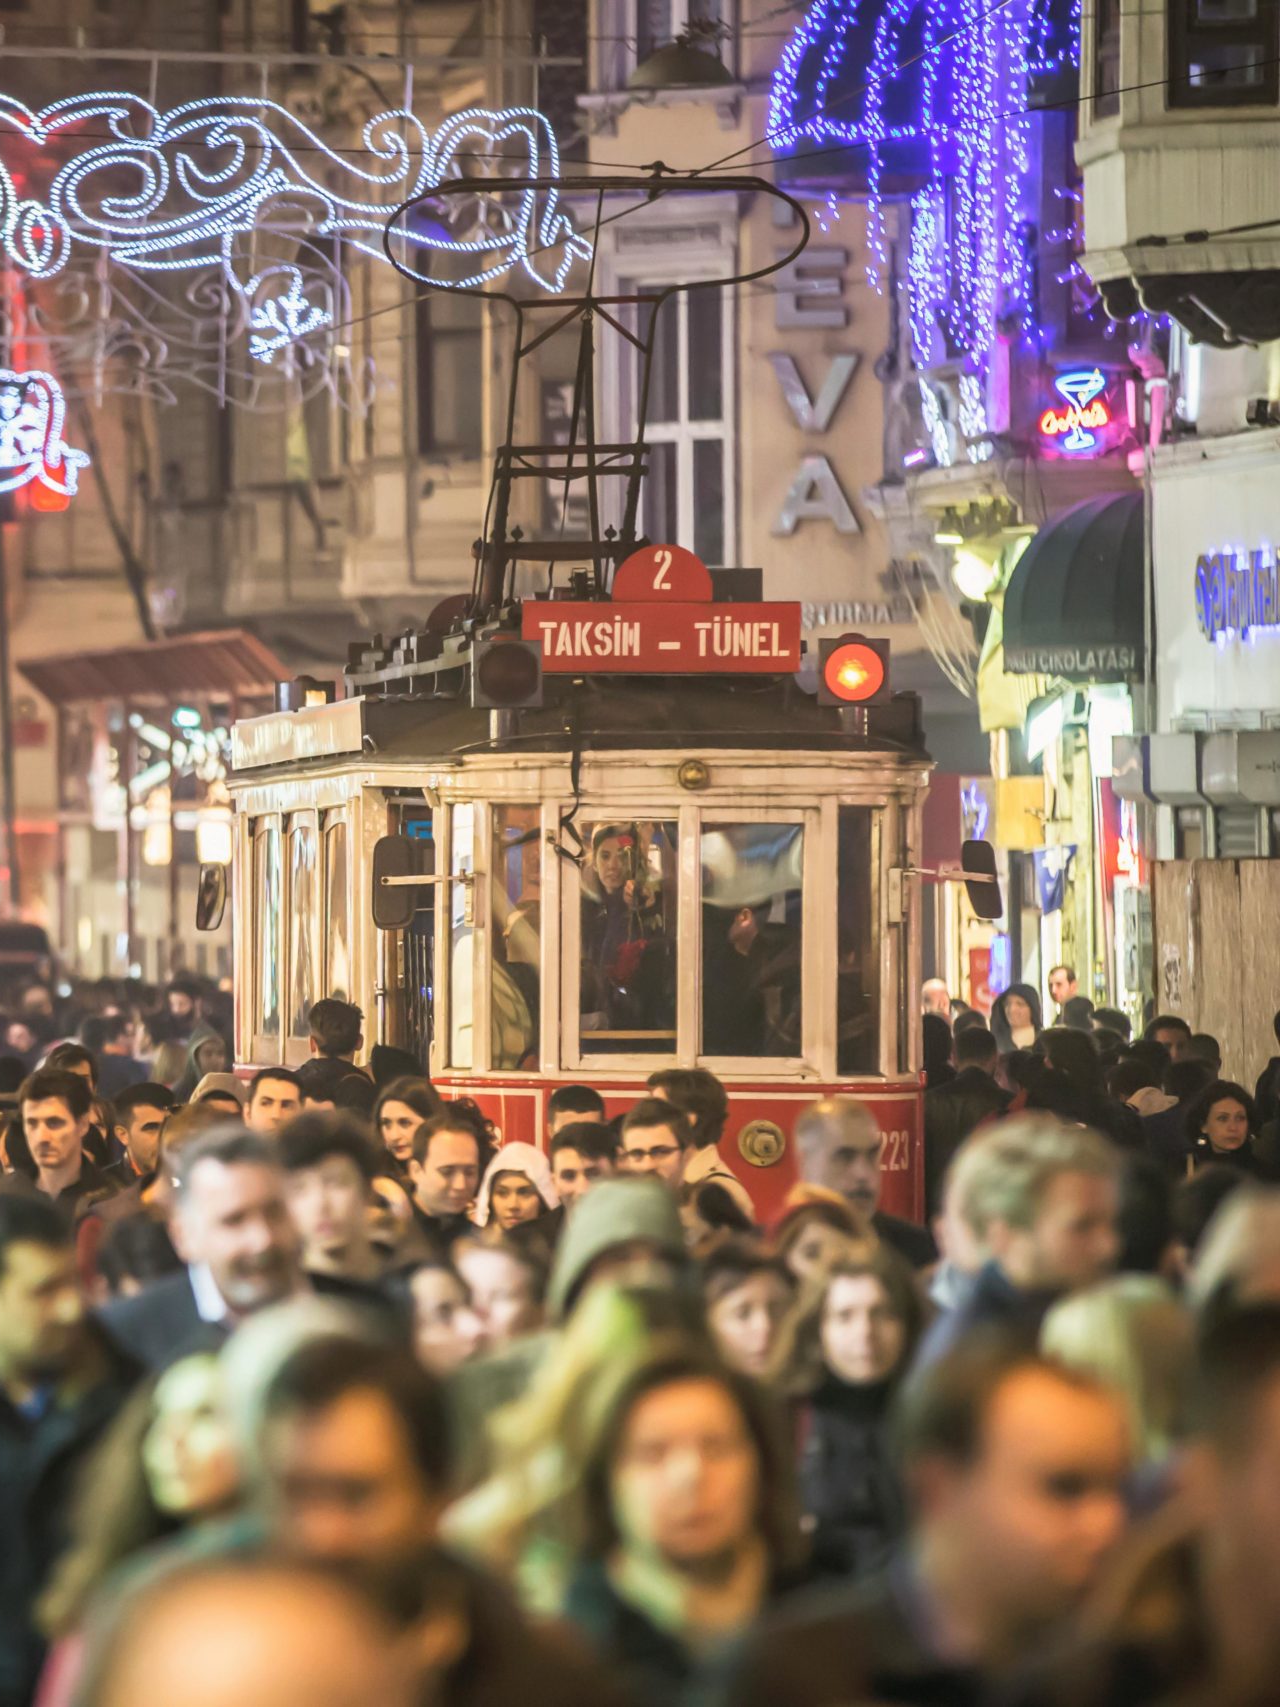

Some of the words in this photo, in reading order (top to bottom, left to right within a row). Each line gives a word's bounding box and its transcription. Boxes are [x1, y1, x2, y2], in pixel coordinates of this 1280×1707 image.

[653, 549, 673, 590] 2
[538, 614, 641, 657] TAKSİM
[694, 615, 790, 657] TÜNEL
